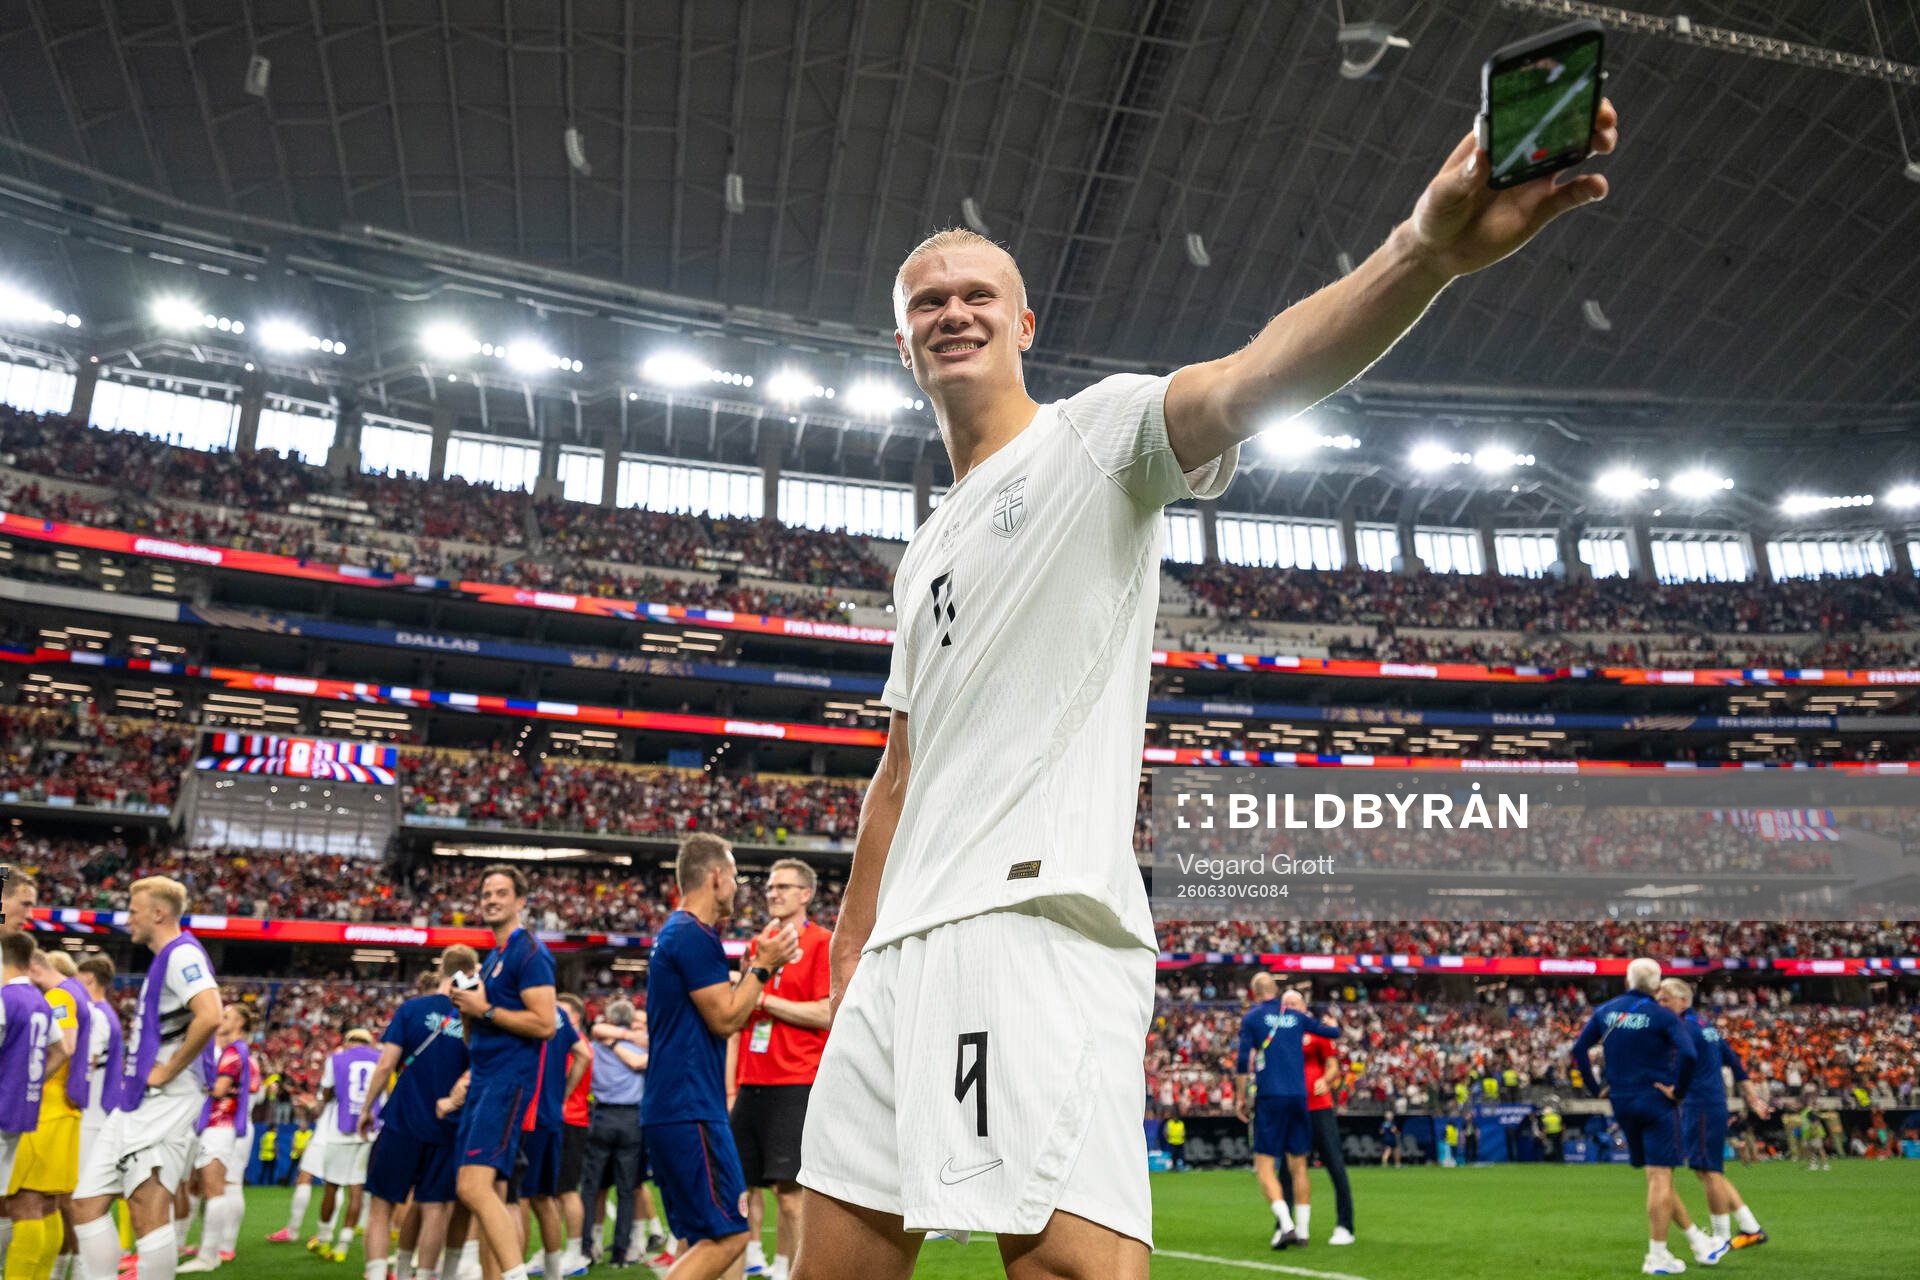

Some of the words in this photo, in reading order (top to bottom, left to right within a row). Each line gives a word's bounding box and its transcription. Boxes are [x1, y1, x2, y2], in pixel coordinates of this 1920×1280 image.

[784, 620, 812, 635] FIFA
[813, 623, 860, 640] WORLD
[860, 628, 886, 641] CUP
[396, 632, 480, 653] DALLAS
[1492, 712, 1555, 726] DALLAS
[954, 1031, 989, 1137] 9
